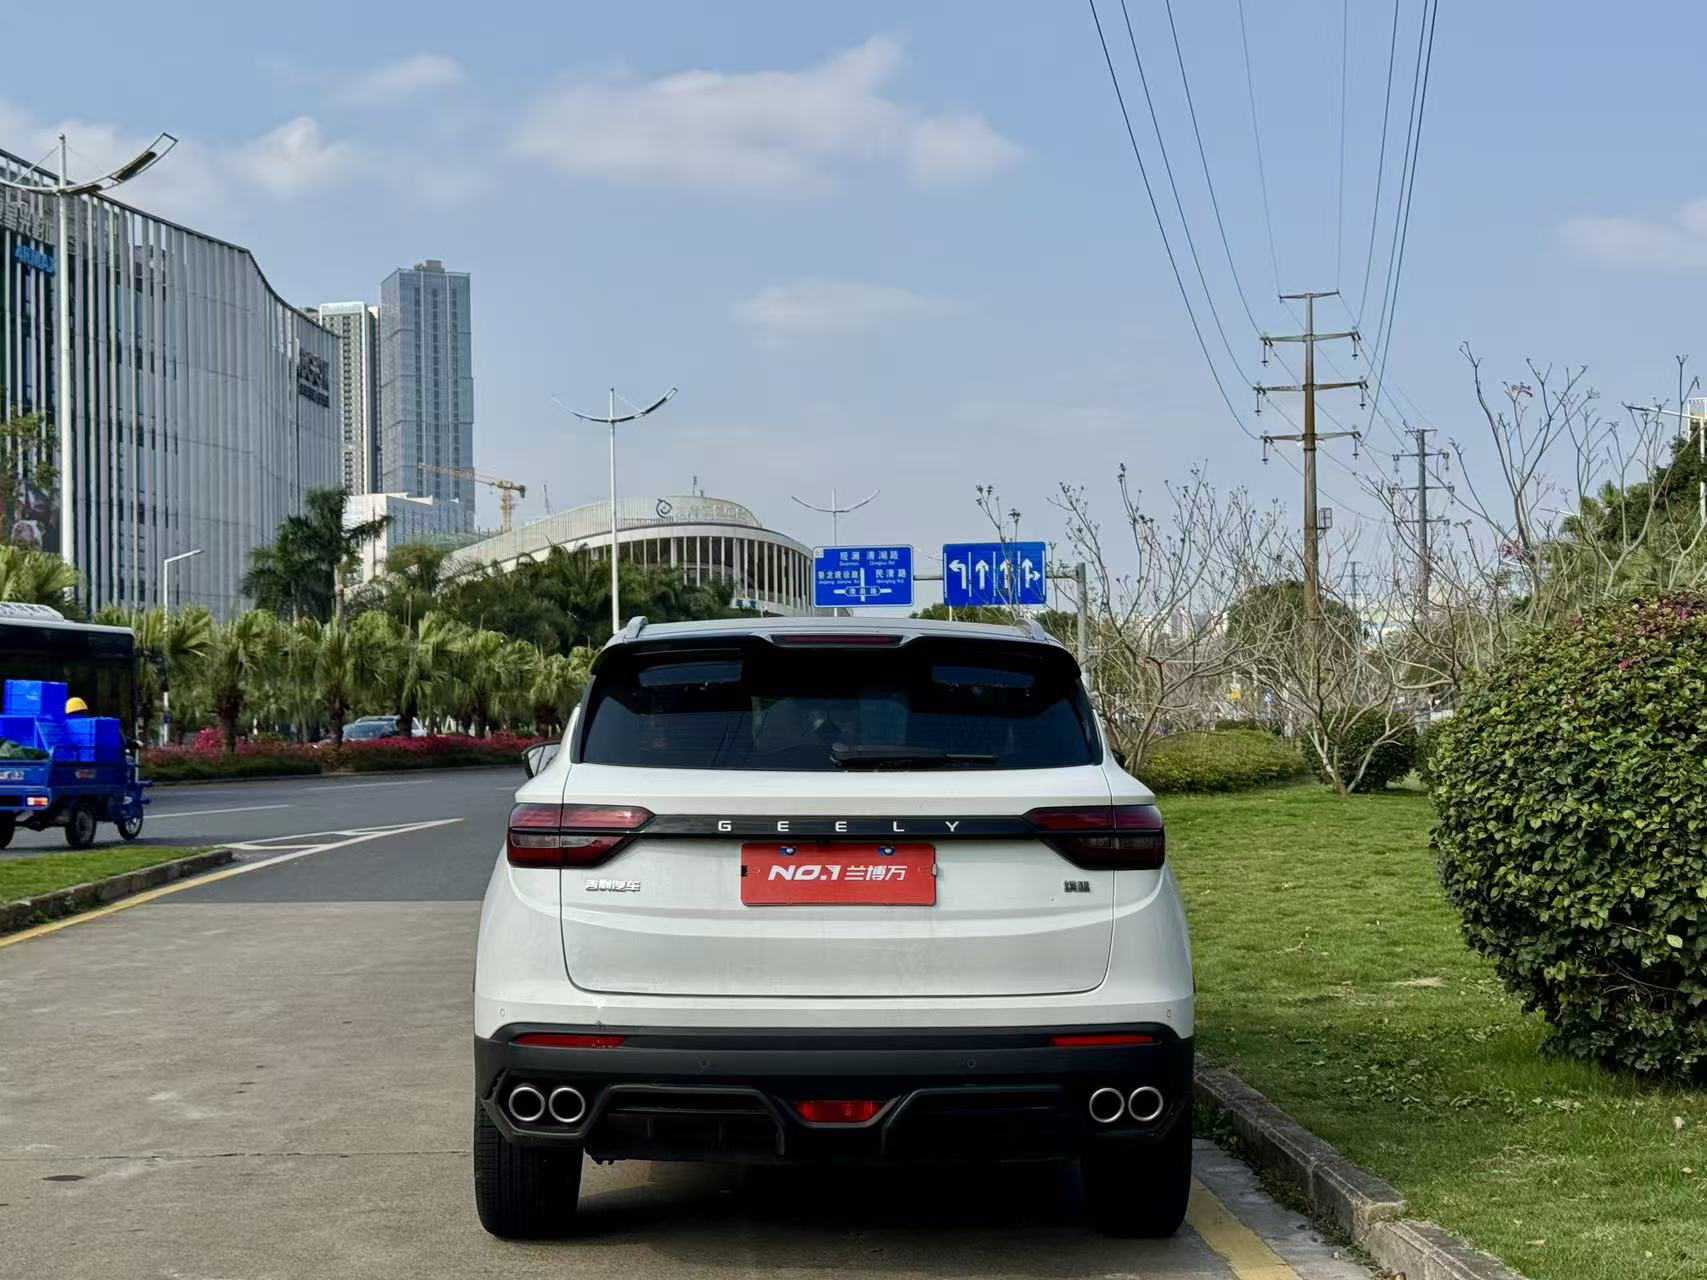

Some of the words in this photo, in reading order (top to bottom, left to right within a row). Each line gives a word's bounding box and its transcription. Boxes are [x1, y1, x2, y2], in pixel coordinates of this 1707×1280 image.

[718, 820, 960, 832] GEELY
[768, 865, 841, 881] NO.1
[844, 865, 908, 881] 兰博万
